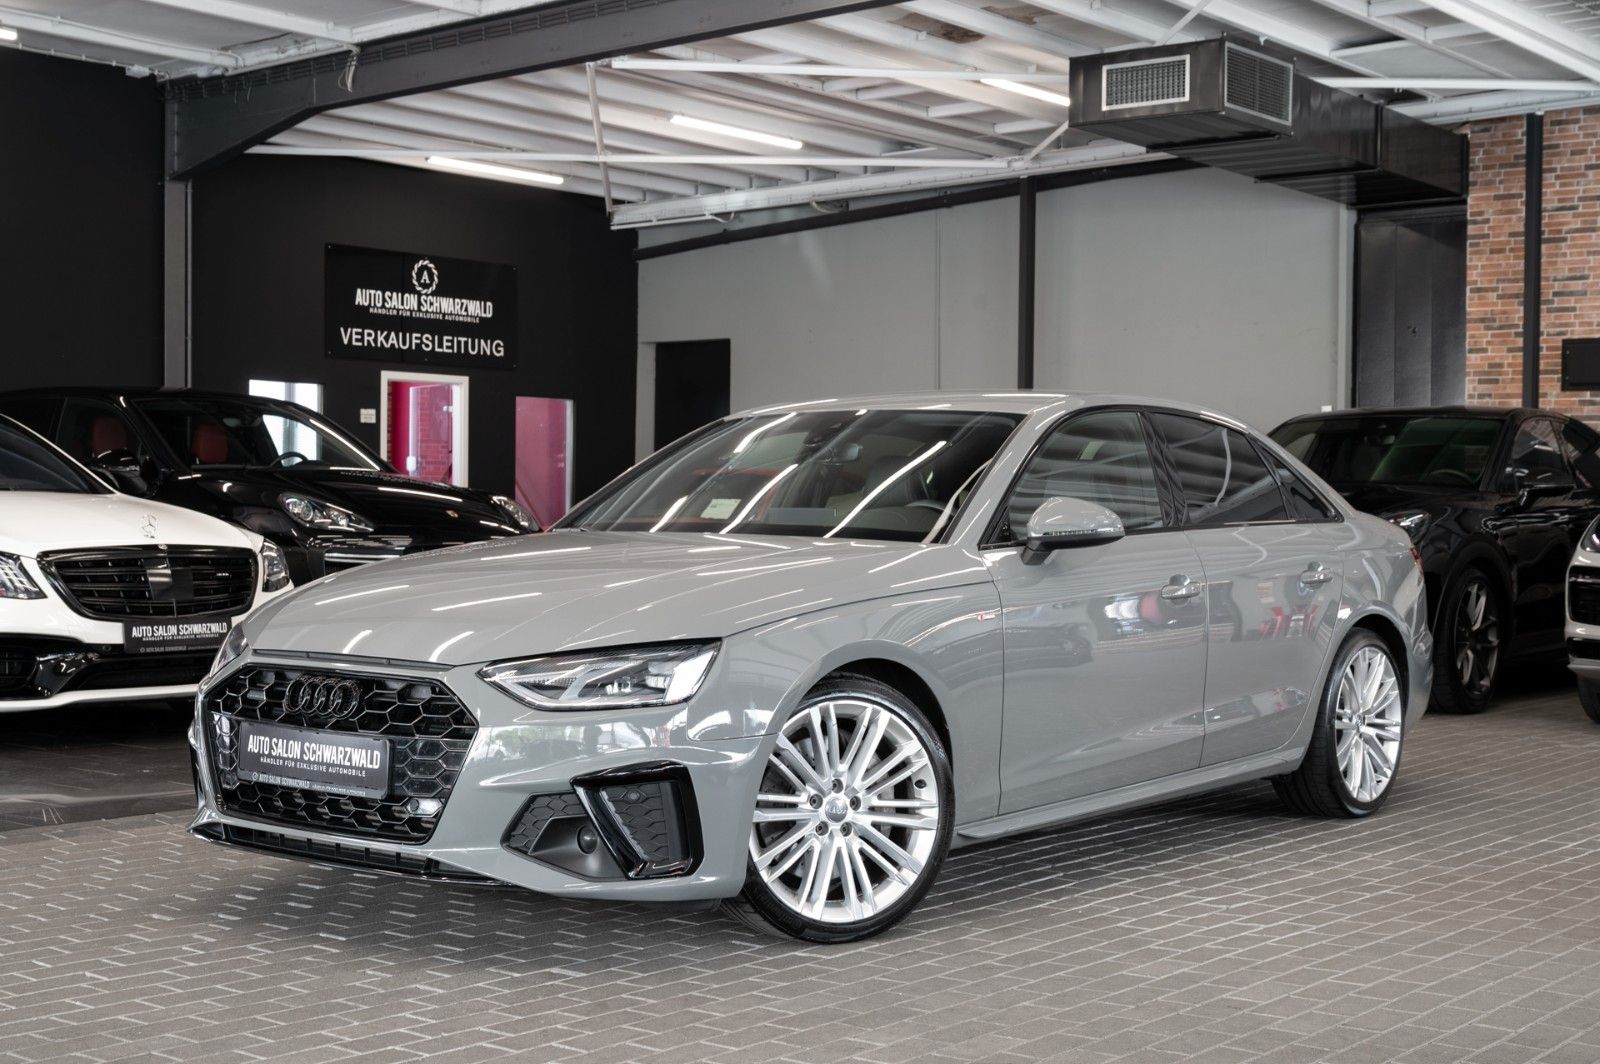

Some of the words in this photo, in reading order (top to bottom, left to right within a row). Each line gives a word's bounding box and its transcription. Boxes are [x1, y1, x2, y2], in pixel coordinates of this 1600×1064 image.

[420, 270, 430, 284] A
[355, 288, 383, 307] AUTO
[384, 291, 418, 311] SALON
[420, 295, 493, 318] SCHWARZWALD
[369, 307, 398, 316] HÄNDLER
[399, 309, 411, 317] FÜR
[412, 311, 443, 320] EXKLUSIVE
[445, 314, 480, 323] AUTOMOBILE
[340, 327, 505, 357] VERKAUFSLEITUNG
[132, 626, 152, 638] AUTO
[153, 625, 177, 636] SALON
[179, 622, 228, 635] SCHWARZWALD
[248, 734, 270, 755] AUTO
[271, 738, 301, 759] SALON
[303, 742, 381, 769] SCHWARZWALD
[260, 756, 284, 766] HÄNDLER
[284, 759, 295, 768] FÜR
[296, 762, 327, 773] EXKLUSIVE
[328, 766, 366, 777] AUTOMOBILE
